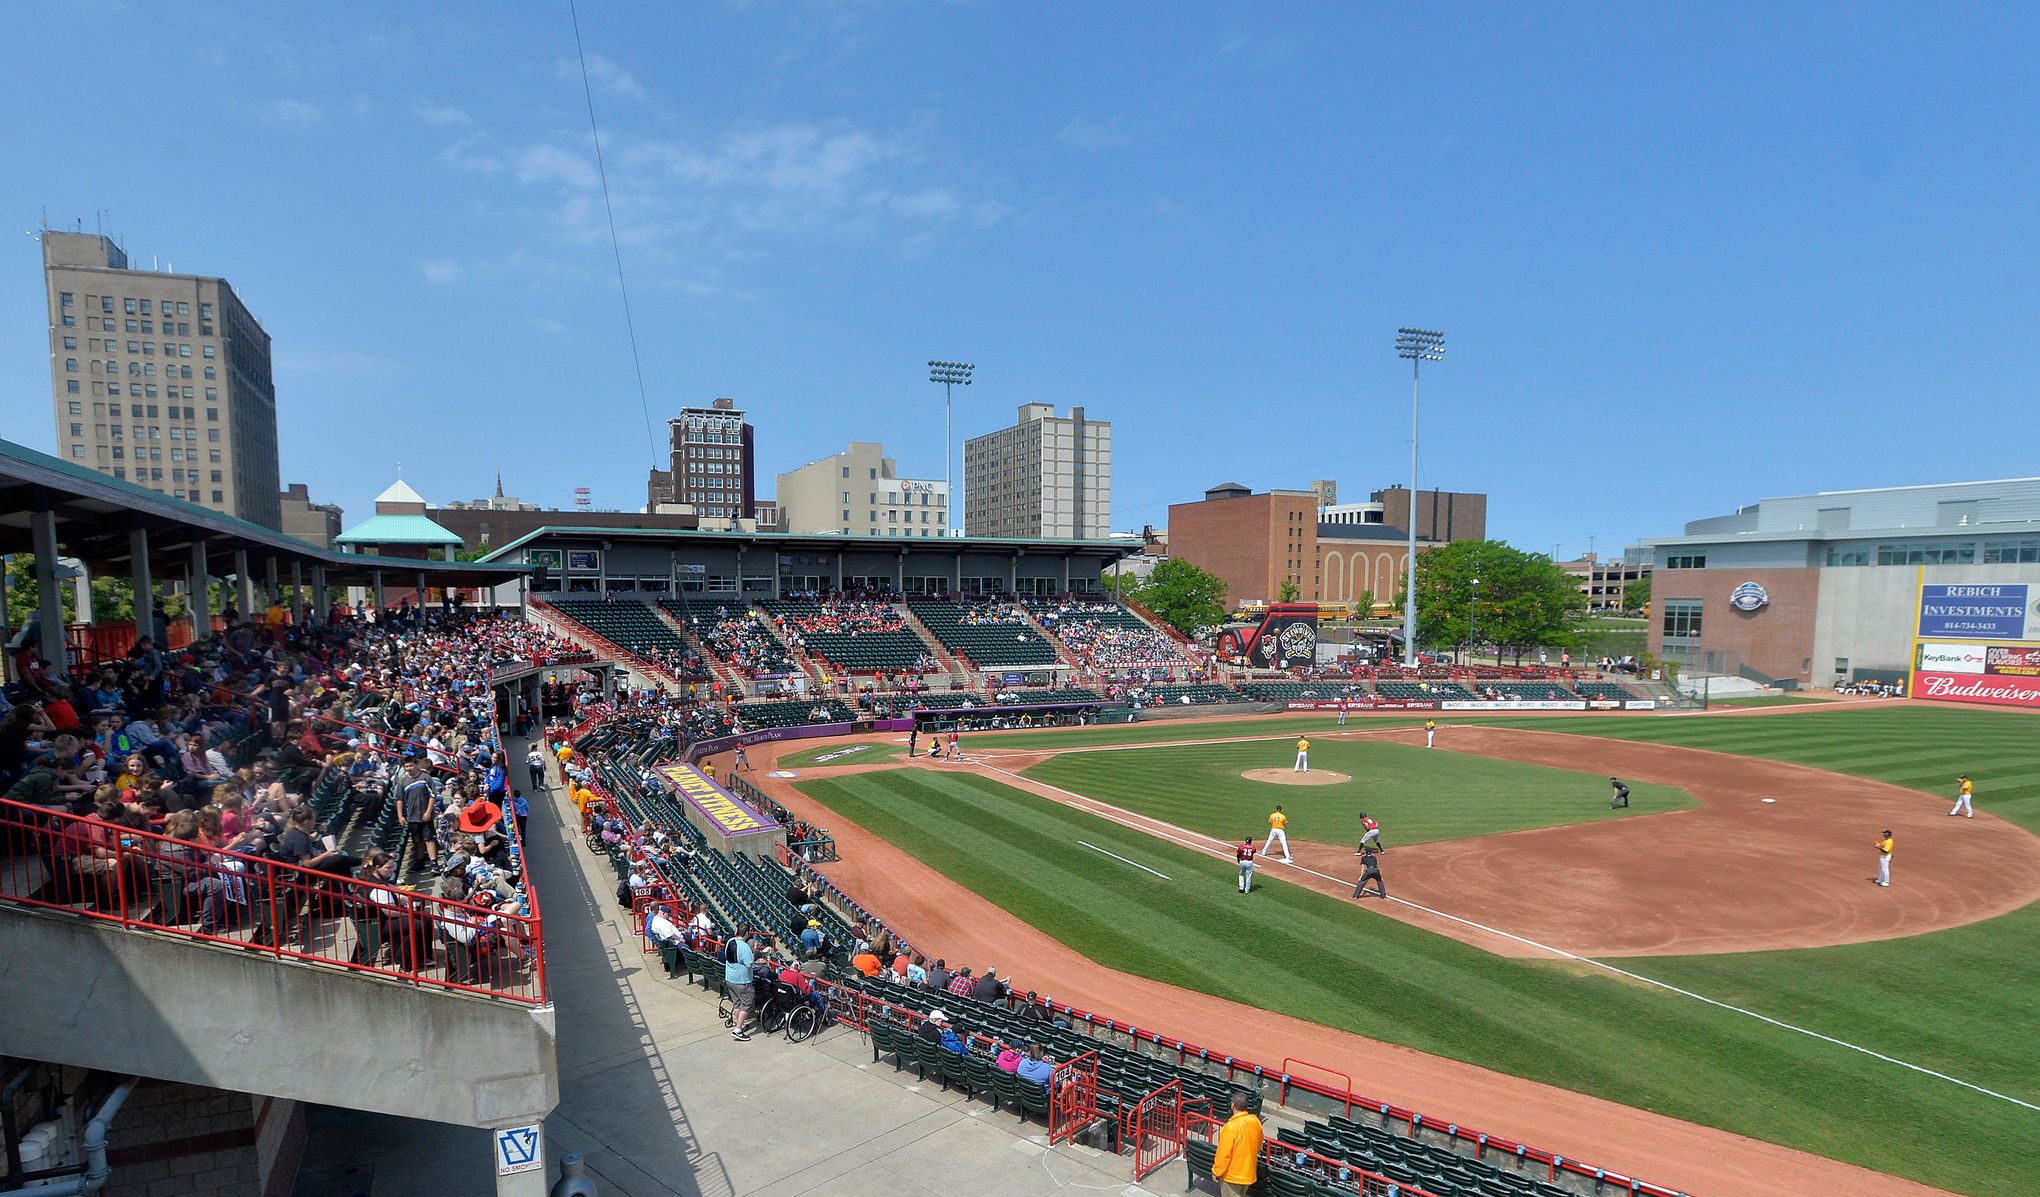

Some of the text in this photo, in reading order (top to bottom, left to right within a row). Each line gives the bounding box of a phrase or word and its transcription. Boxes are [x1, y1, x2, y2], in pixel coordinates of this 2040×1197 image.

[911, 482, 934, 492] PNC
[1946, 586, 2001, 597] REBICH
[1924, 605, 2023, 617] INVESTMENTS
[1944, 622, 1996, 630] 814-734-3433
[1924, 655, 1961, 663] KeyBank
[1923, 676, 2040, 700] Budweiser
[691, 792, 761, 832] FITNESS
[1056, 1067, 1071, 1081] 104
[1143, 1098, 1157, 1112] 103
